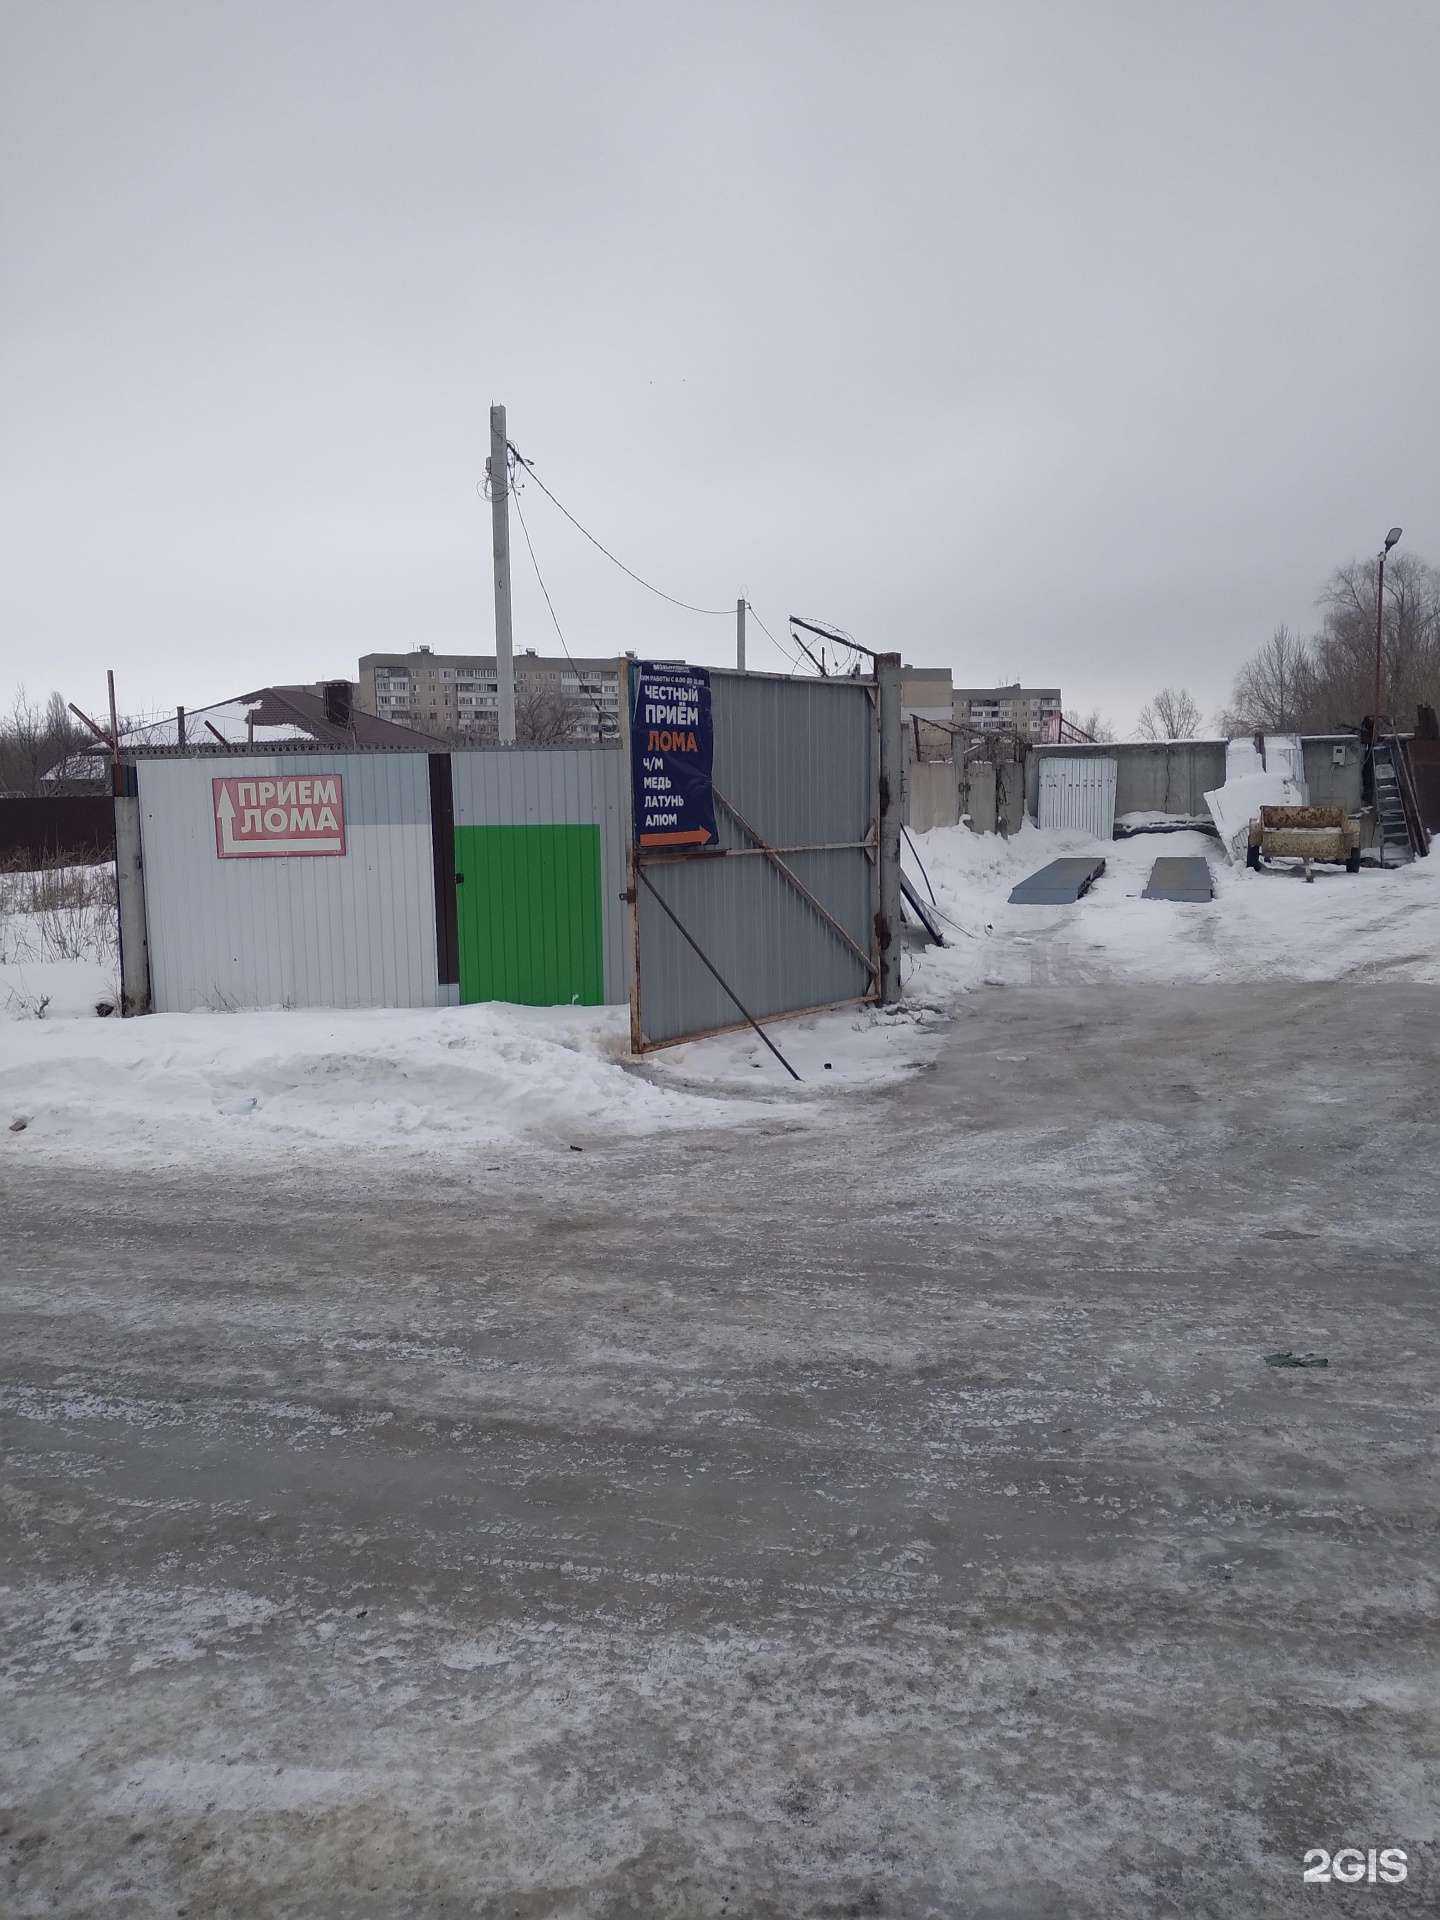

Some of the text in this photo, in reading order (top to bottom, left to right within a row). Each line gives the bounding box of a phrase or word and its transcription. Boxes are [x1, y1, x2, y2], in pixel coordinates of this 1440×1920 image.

[645, 685, 699, 702] ЧЕСТНЫЙ
[645, 702, 699, 726] ПРИЁМ
[647, 731, 699, 752] ЛОМА
[643, 756, 664, 771] Ч/М
[643, 776, 672, 790] МЕДЬ
[237, 780, 338, 807] ПРИЕМ
[644, 795, 684, 807] ЛАТУНЬ
[240, 806, 340, 833] ЛОМА
[645, 813, 678, 827] АЛЮМ
